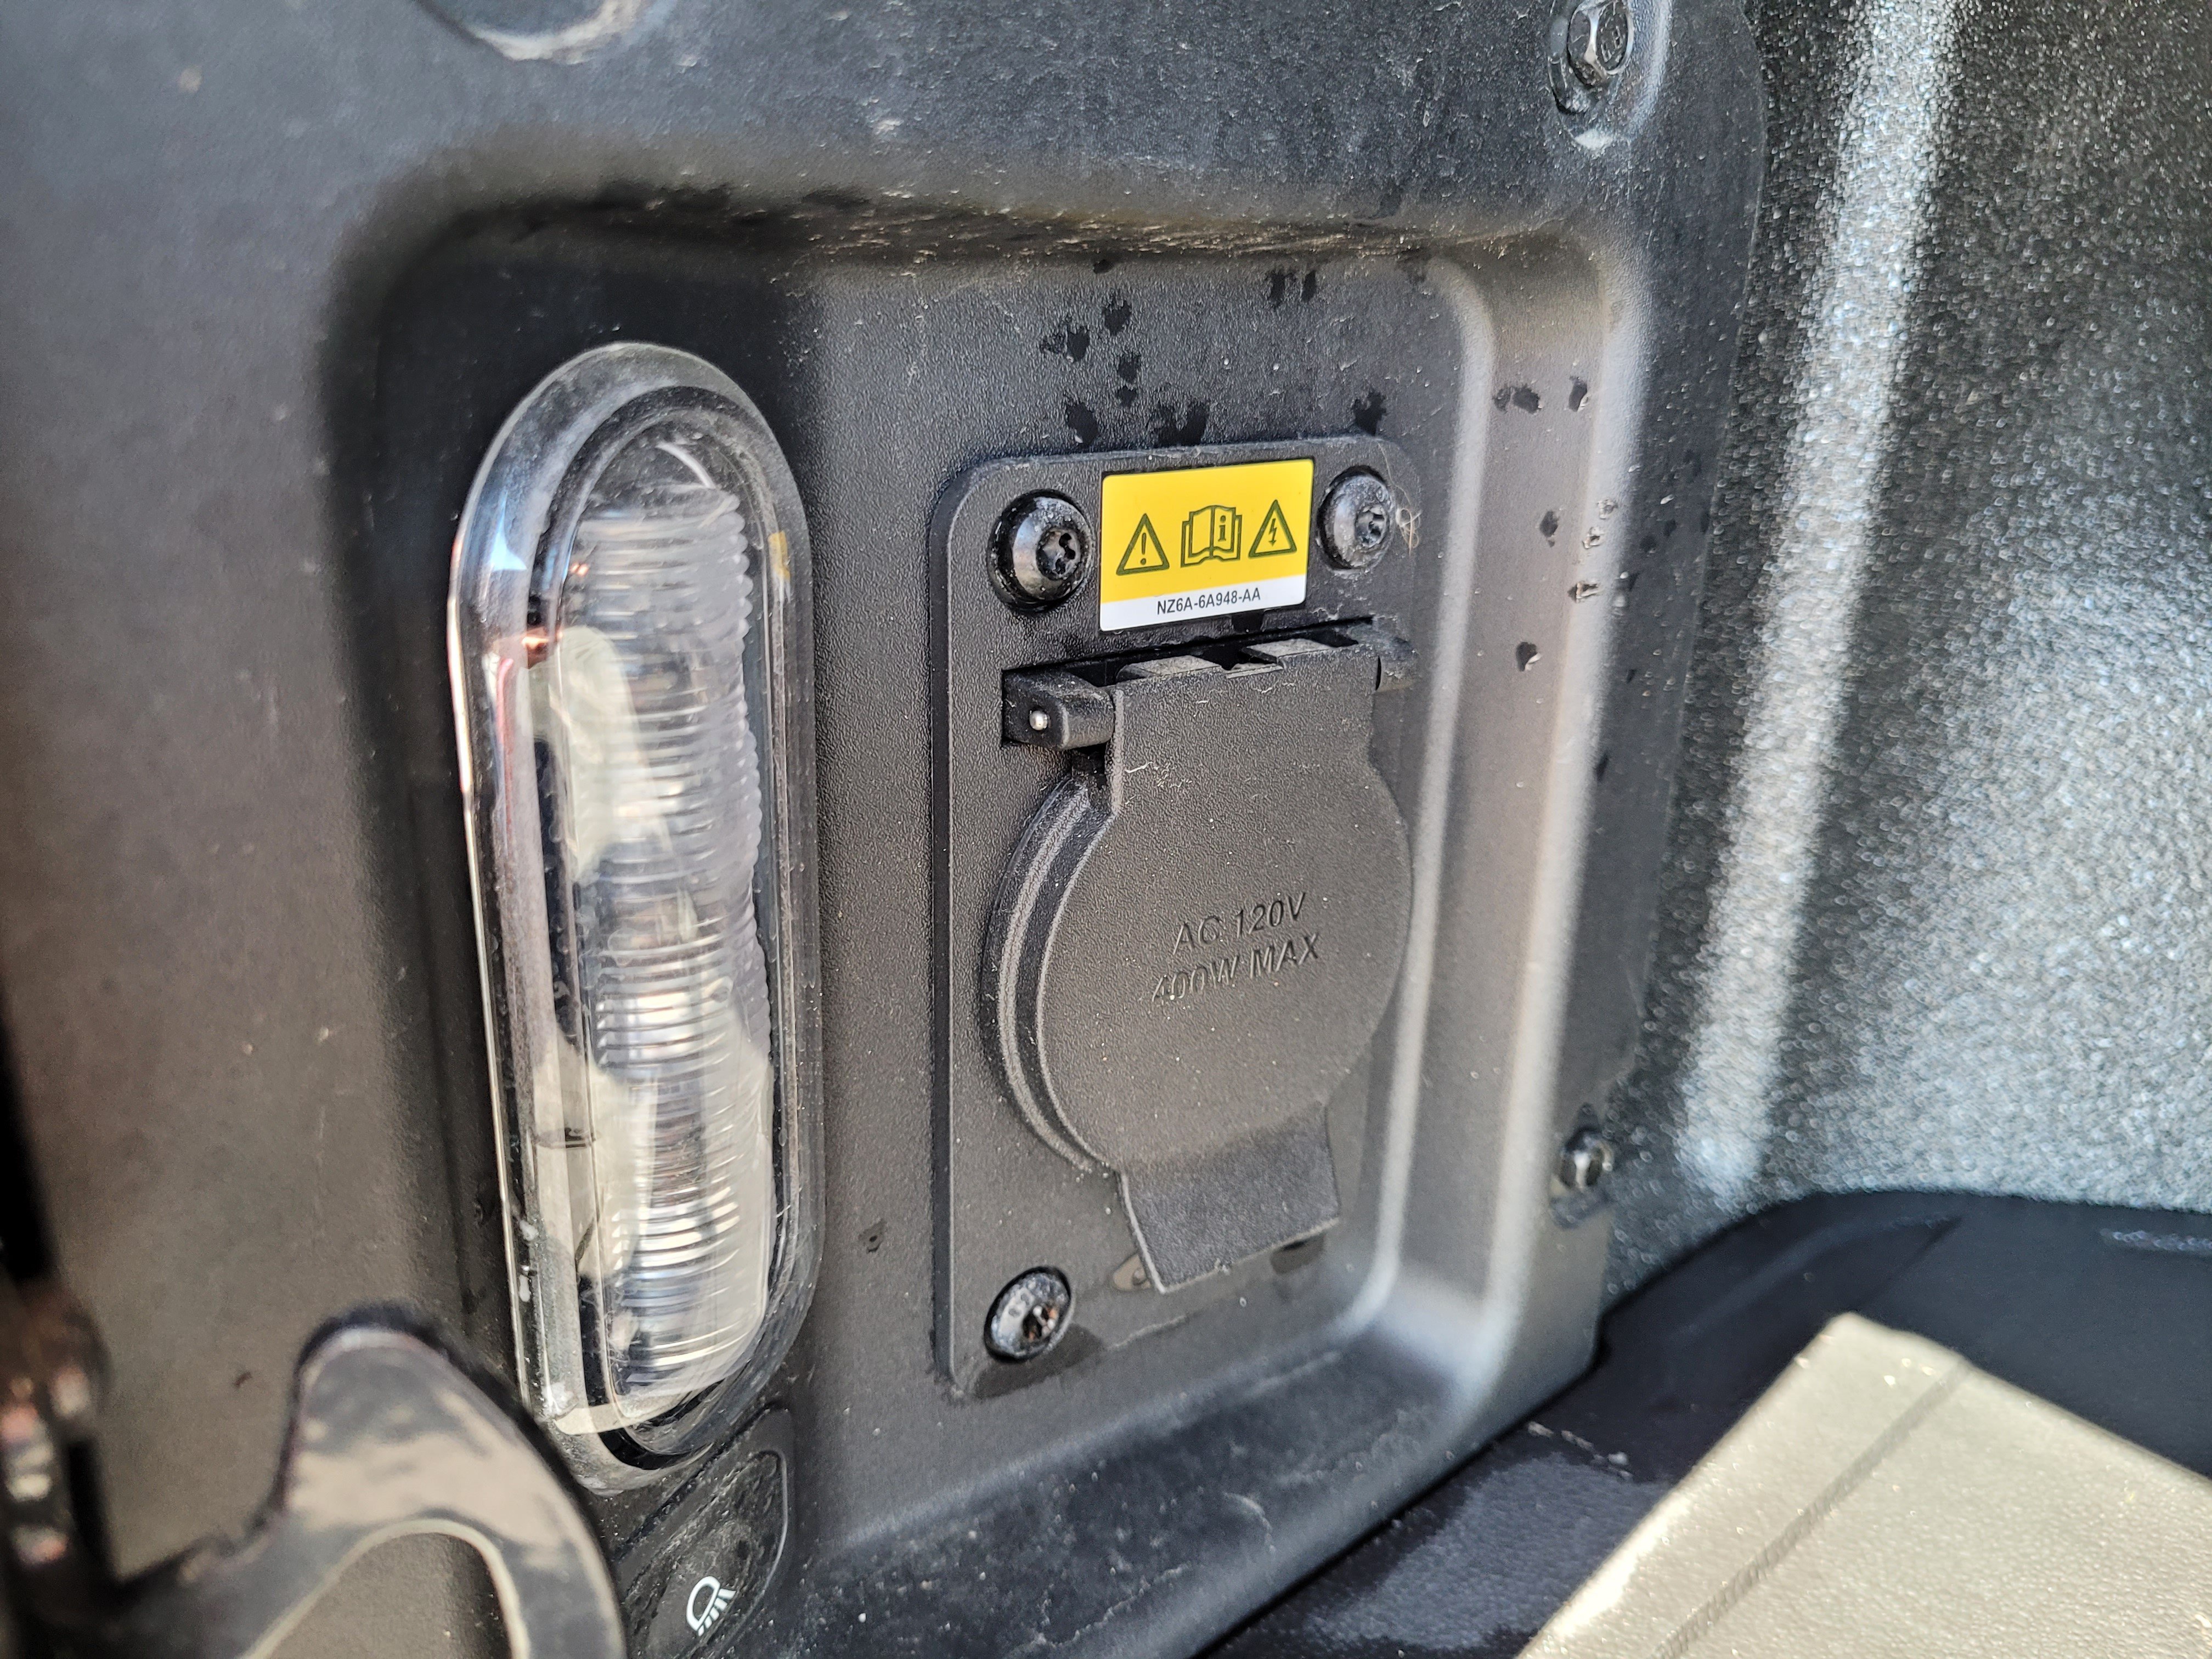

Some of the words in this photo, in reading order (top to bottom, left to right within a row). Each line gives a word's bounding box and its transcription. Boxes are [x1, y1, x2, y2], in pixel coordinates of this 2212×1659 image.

[1157, 588, 1261, 615] NZ6A-6A948-AA
[1173, 915, 1222, 955] AC
[1235, 891, 1306, 939] 120V
[1152, 955, 1239, 1002] 400W
[1249, 932, 1319, 979] MAX
